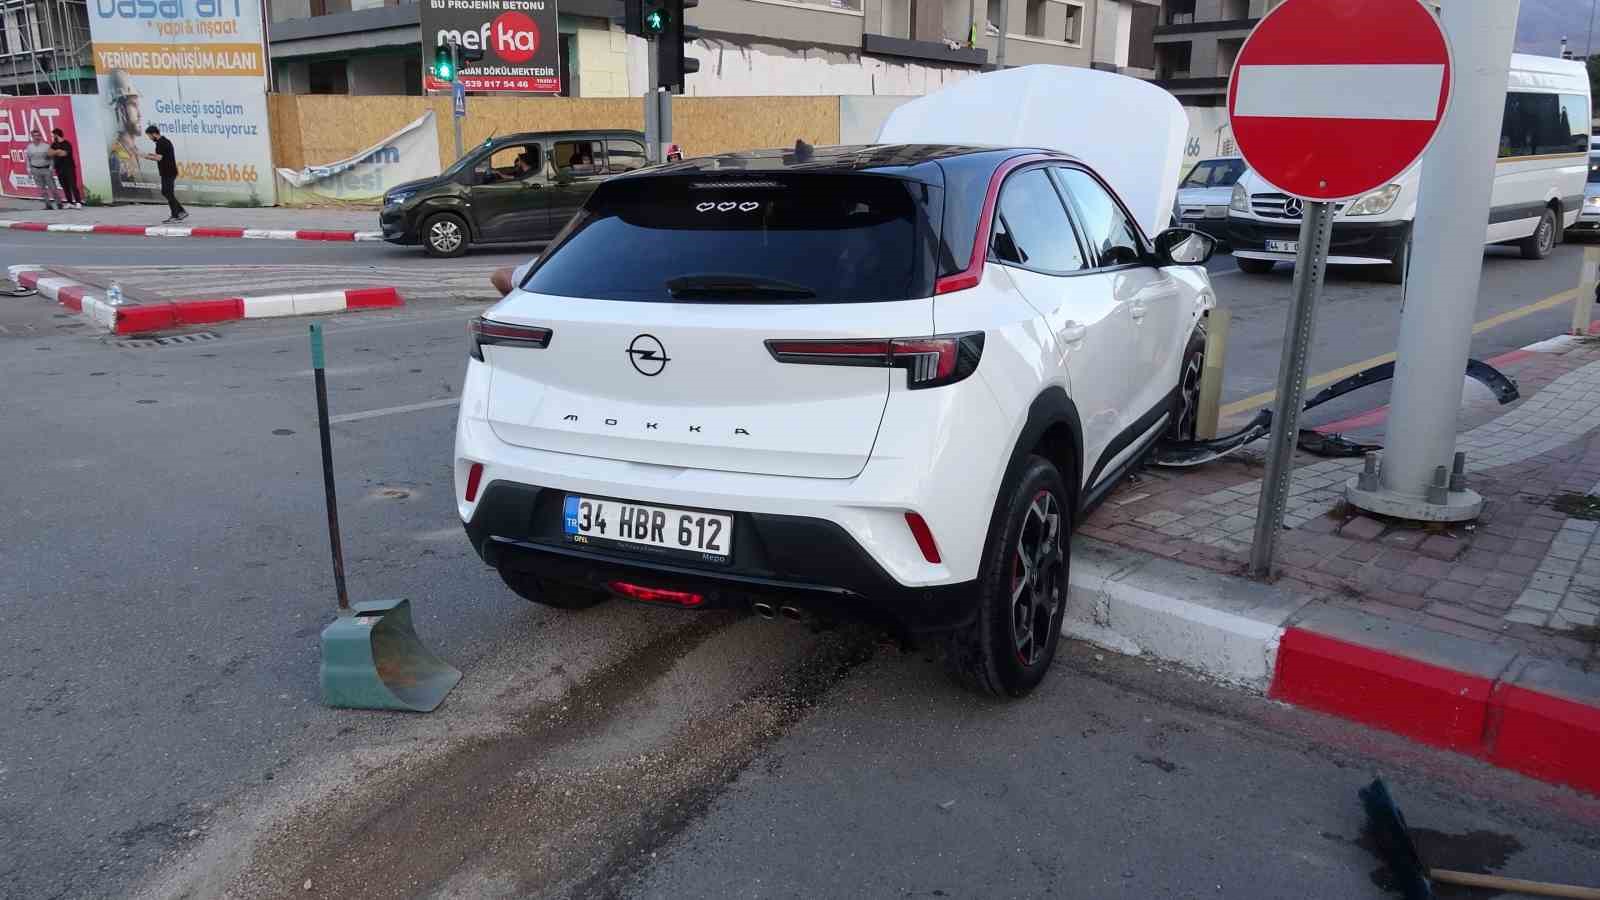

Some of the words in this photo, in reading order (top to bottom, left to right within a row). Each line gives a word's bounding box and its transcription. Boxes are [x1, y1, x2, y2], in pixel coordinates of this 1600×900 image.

[430, 0, 445, 8] BU
[448, 0, 499, 9] PROJENİN
[502, 1, 545, 10] BETONU
[98, 48, 150, 69] YERİNDE
[152, 48, 216, 74] DÖNÜŞÜM
[217, 52, 256, 70] ALANI
[155, 100, 200, 118] Geleceği
[203, 101, 244, 119] sağlam
[201, 122, 258, 139] kuruyoruz
[241, 163, 258, 183] 66
[563, 413, 751, 436] MOKKA
[567, 517, 578, 528] TR
[579, 501, 607, 535] 34
[619, 506, 666, 543] HBR
[678, 514, 723, 551] 612
